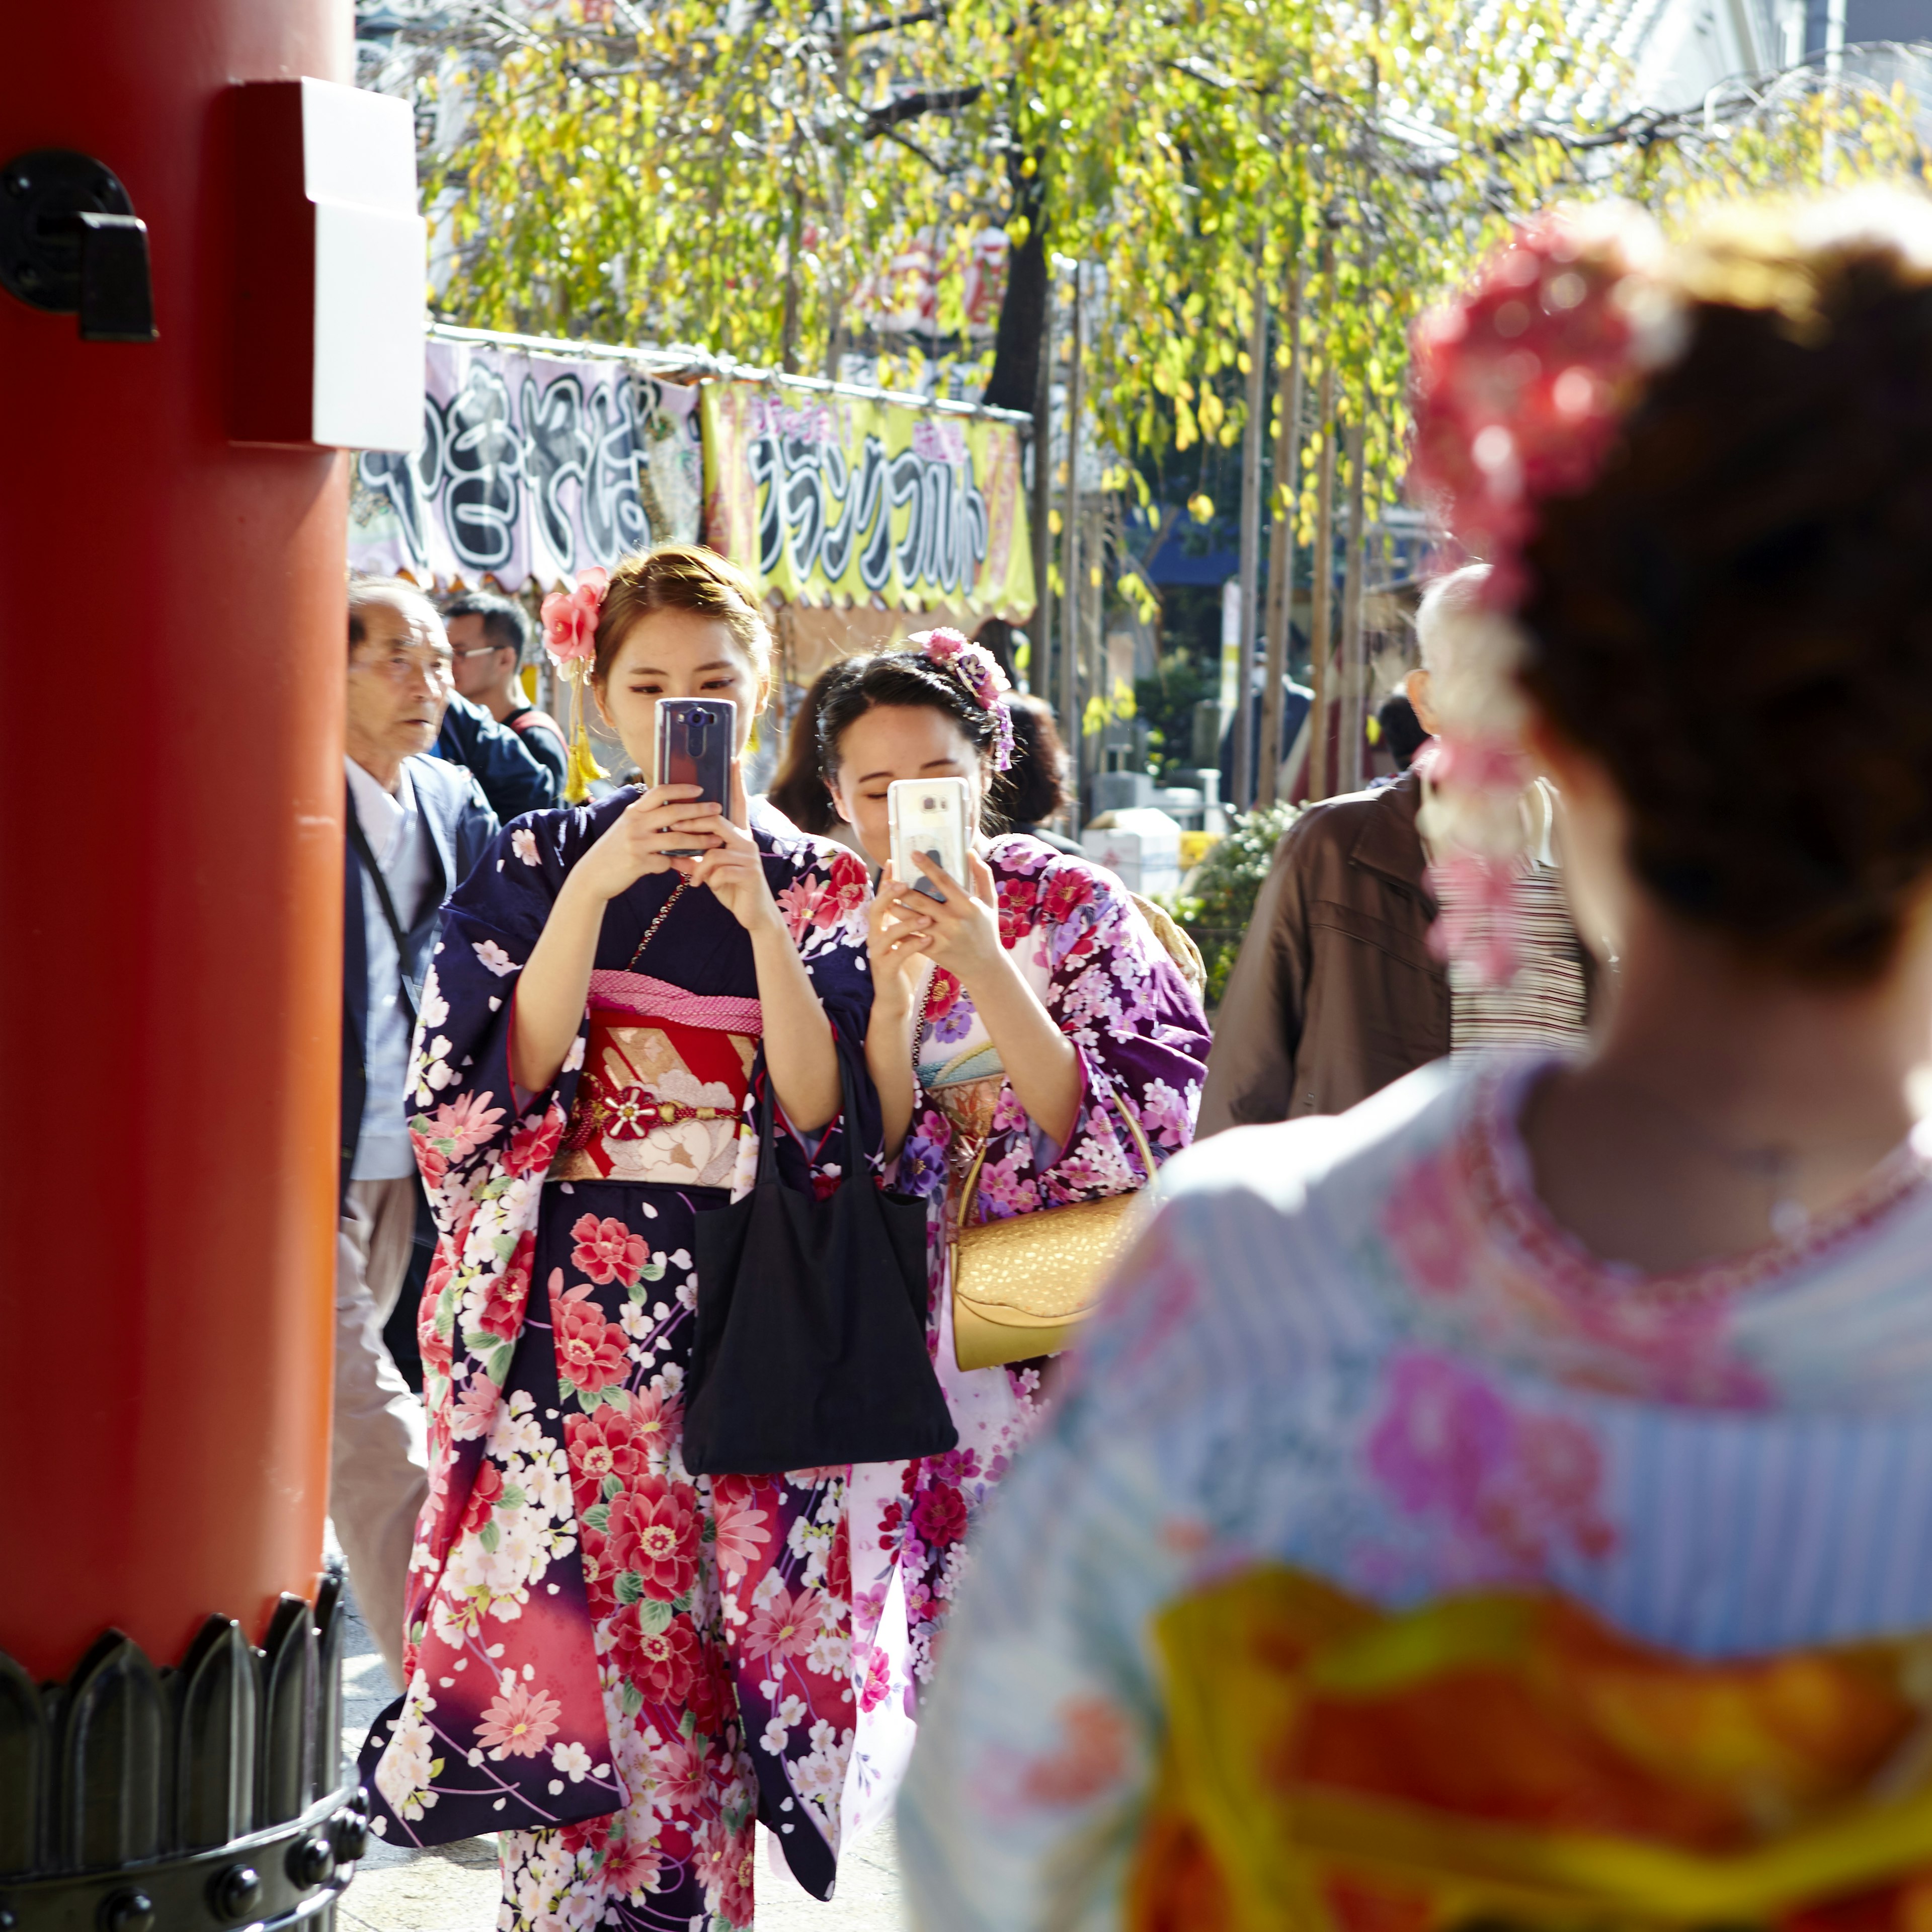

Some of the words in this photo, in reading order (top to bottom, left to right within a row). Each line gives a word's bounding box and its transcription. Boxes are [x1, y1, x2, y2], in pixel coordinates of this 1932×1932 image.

[747, 433, 989, 597] フランクフルト
